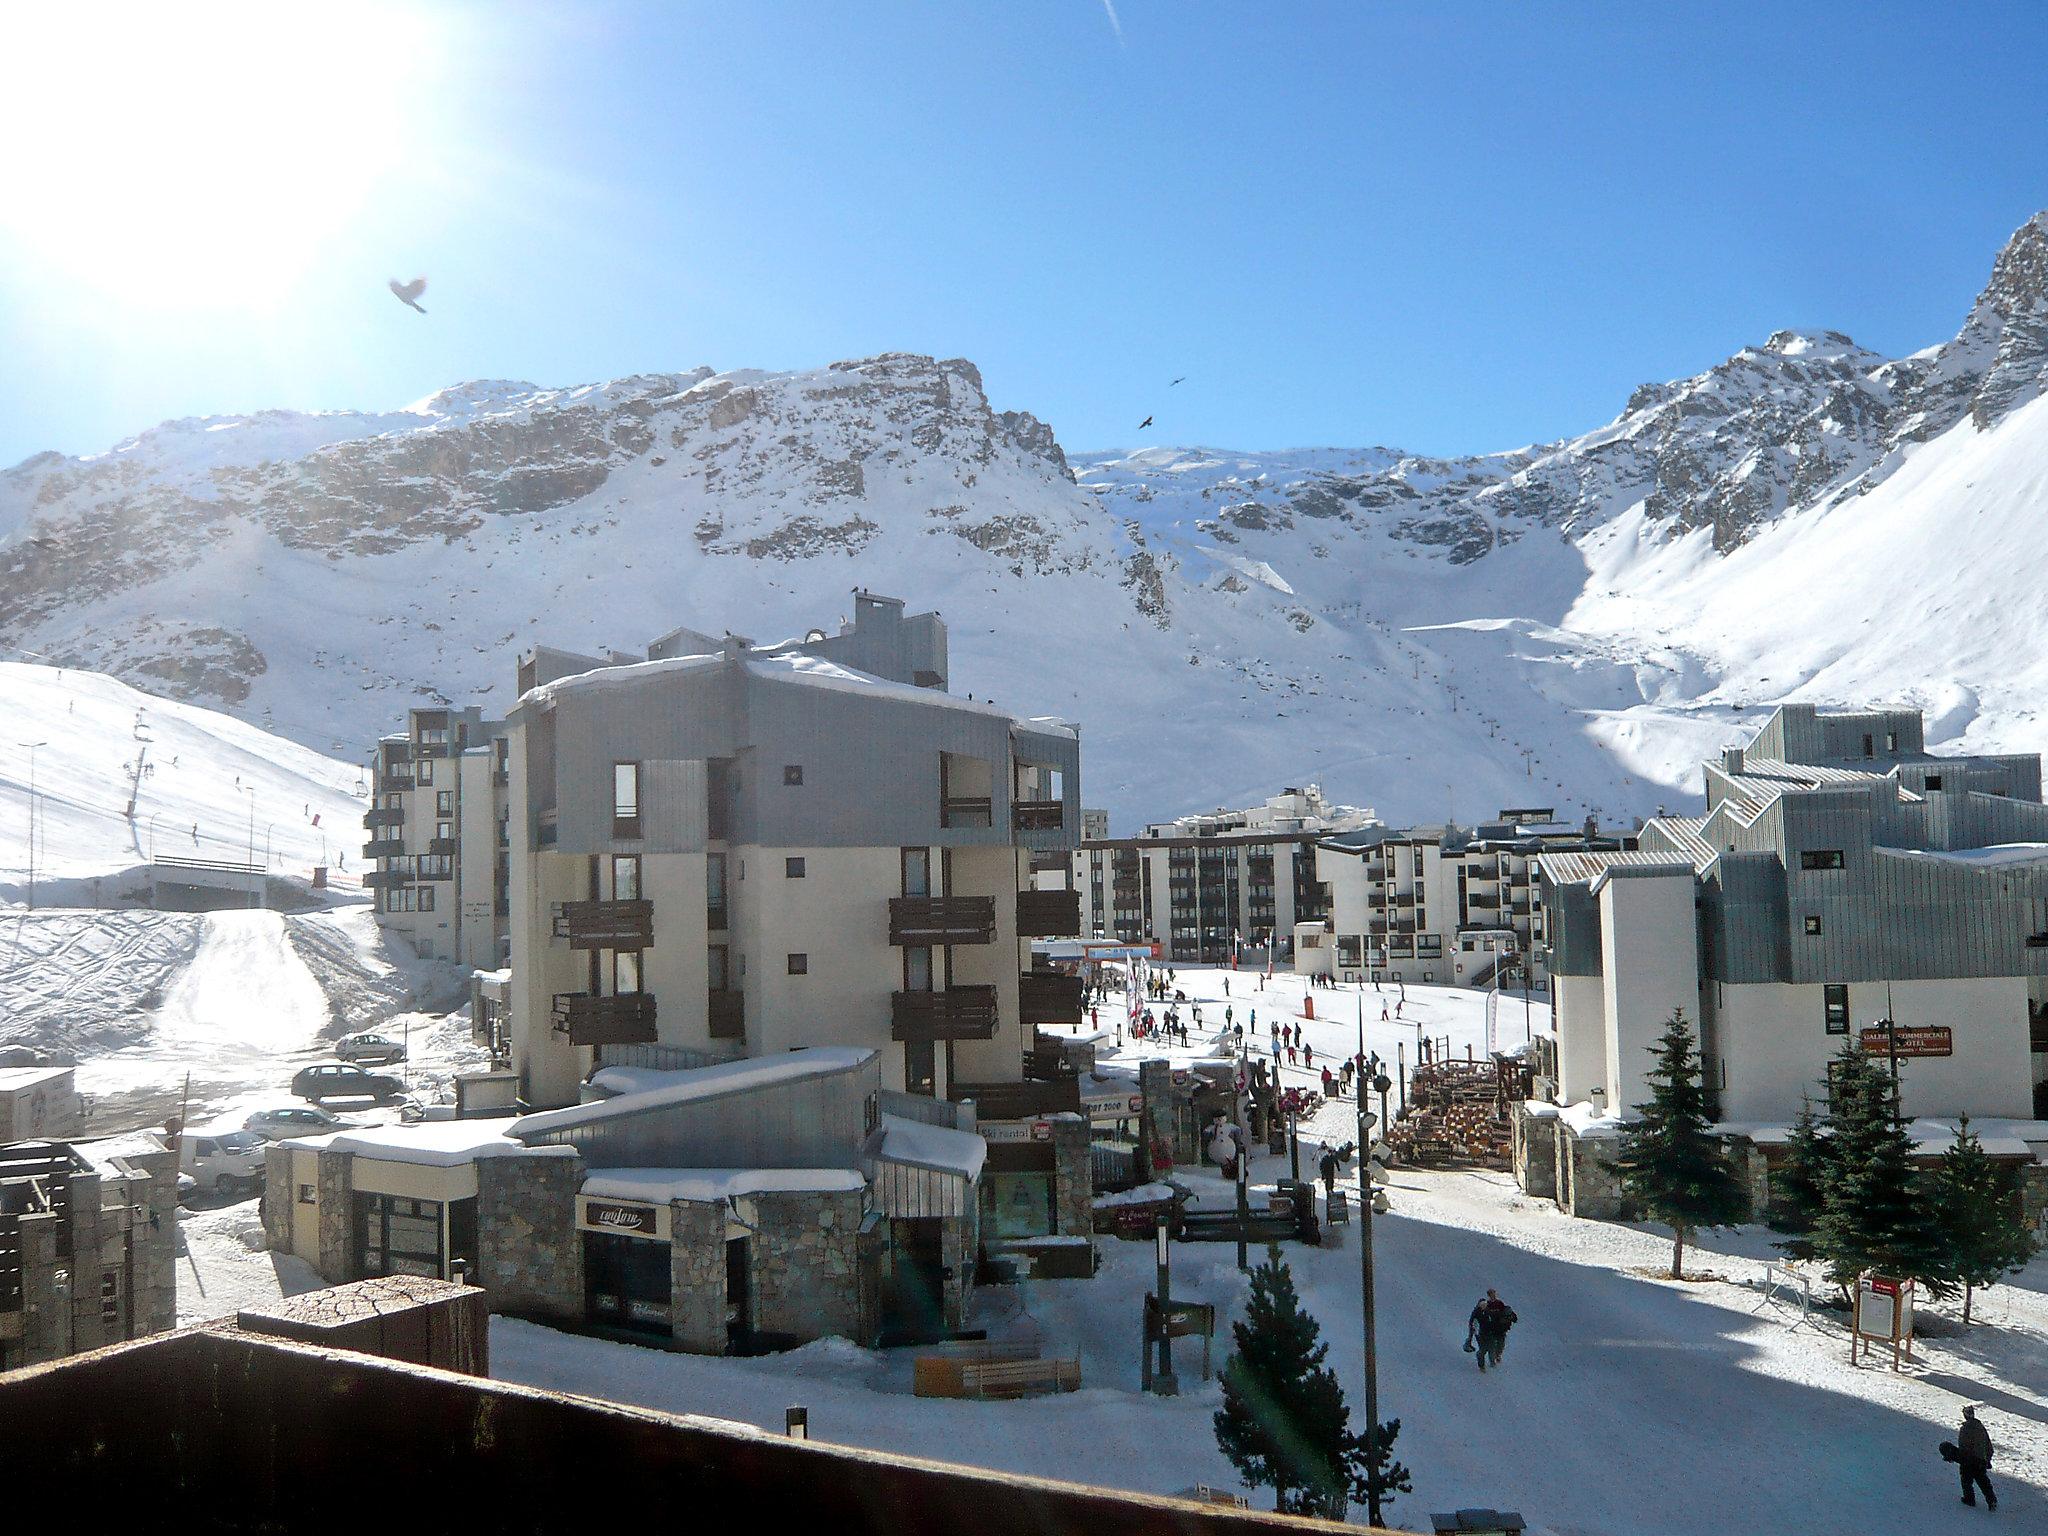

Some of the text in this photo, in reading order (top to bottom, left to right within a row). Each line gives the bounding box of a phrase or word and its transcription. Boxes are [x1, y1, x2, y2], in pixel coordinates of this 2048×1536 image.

[1863, 1033, 1890, 1041] GALERI
[1103, 1102, 1121, 1111] 2000
[981, 1127, 996, 1138] Ski
